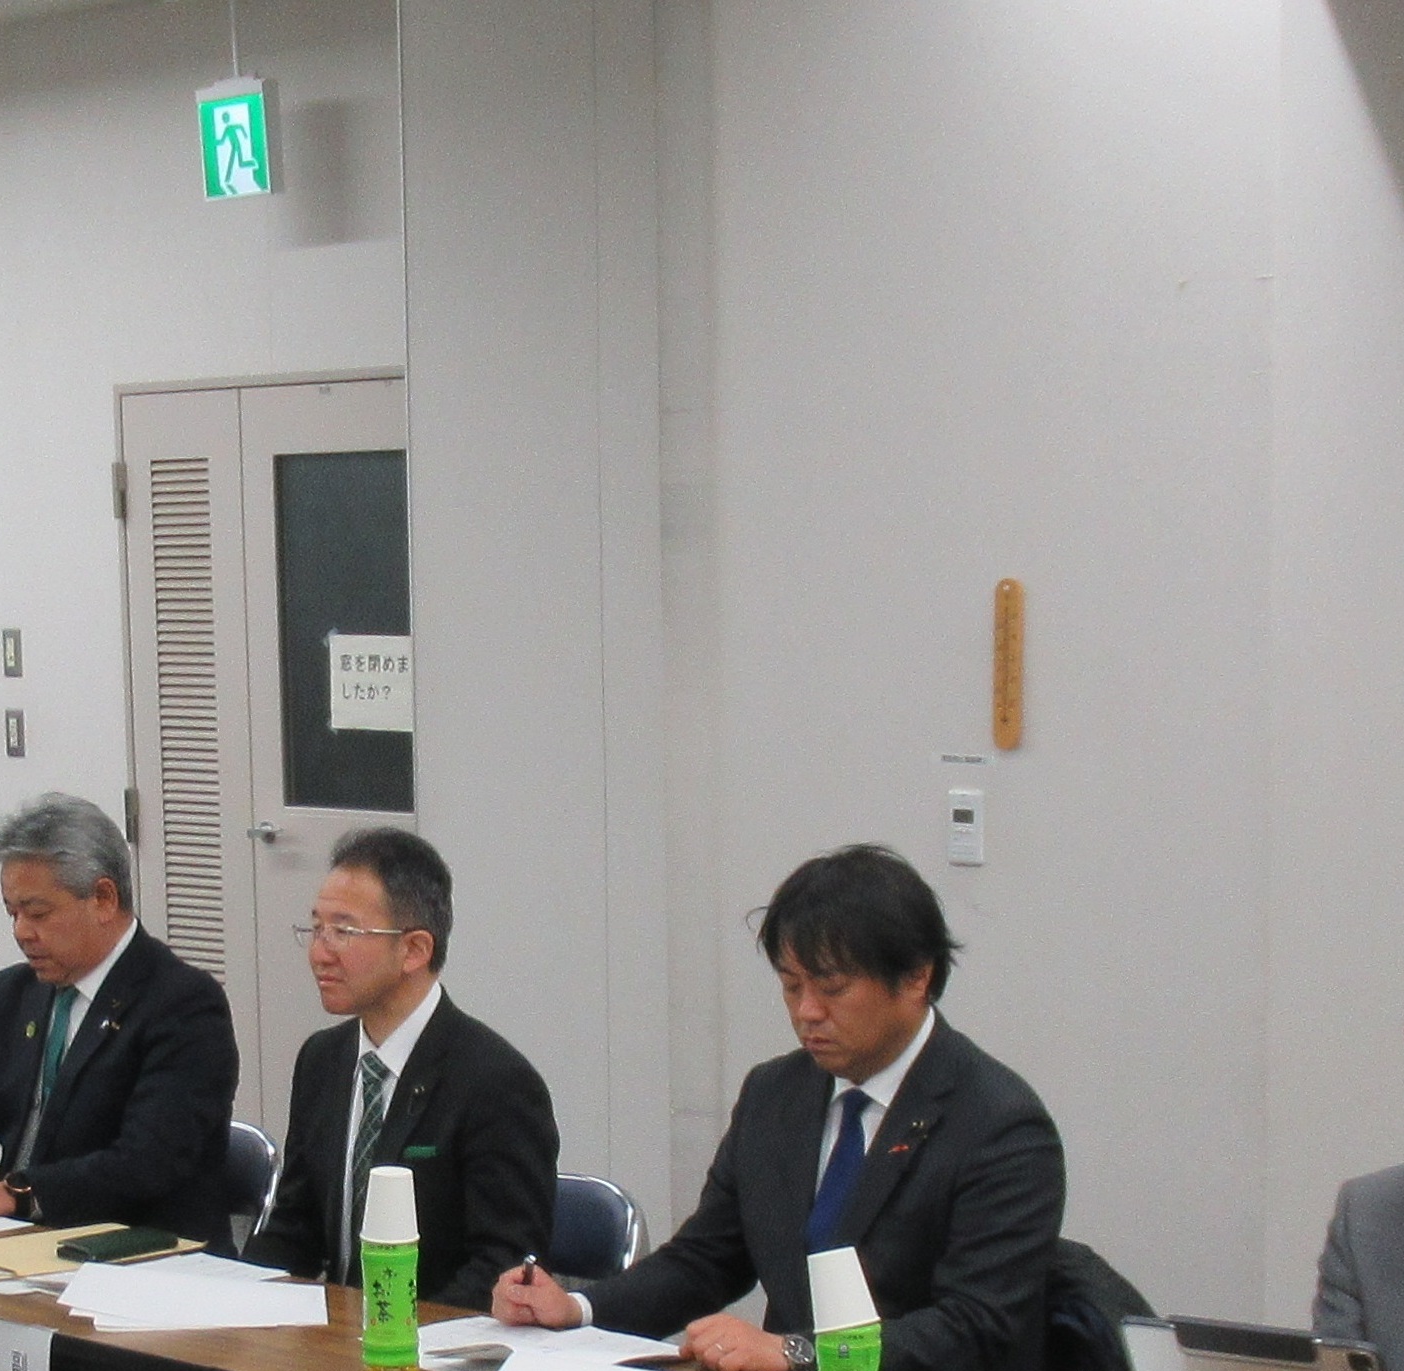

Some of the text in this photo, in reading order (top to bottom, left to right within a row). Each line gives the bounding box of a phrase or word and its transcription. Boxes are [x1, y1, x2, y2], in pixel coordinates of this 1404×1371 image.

[340, 654, 409, 673] 窓を閉めま
